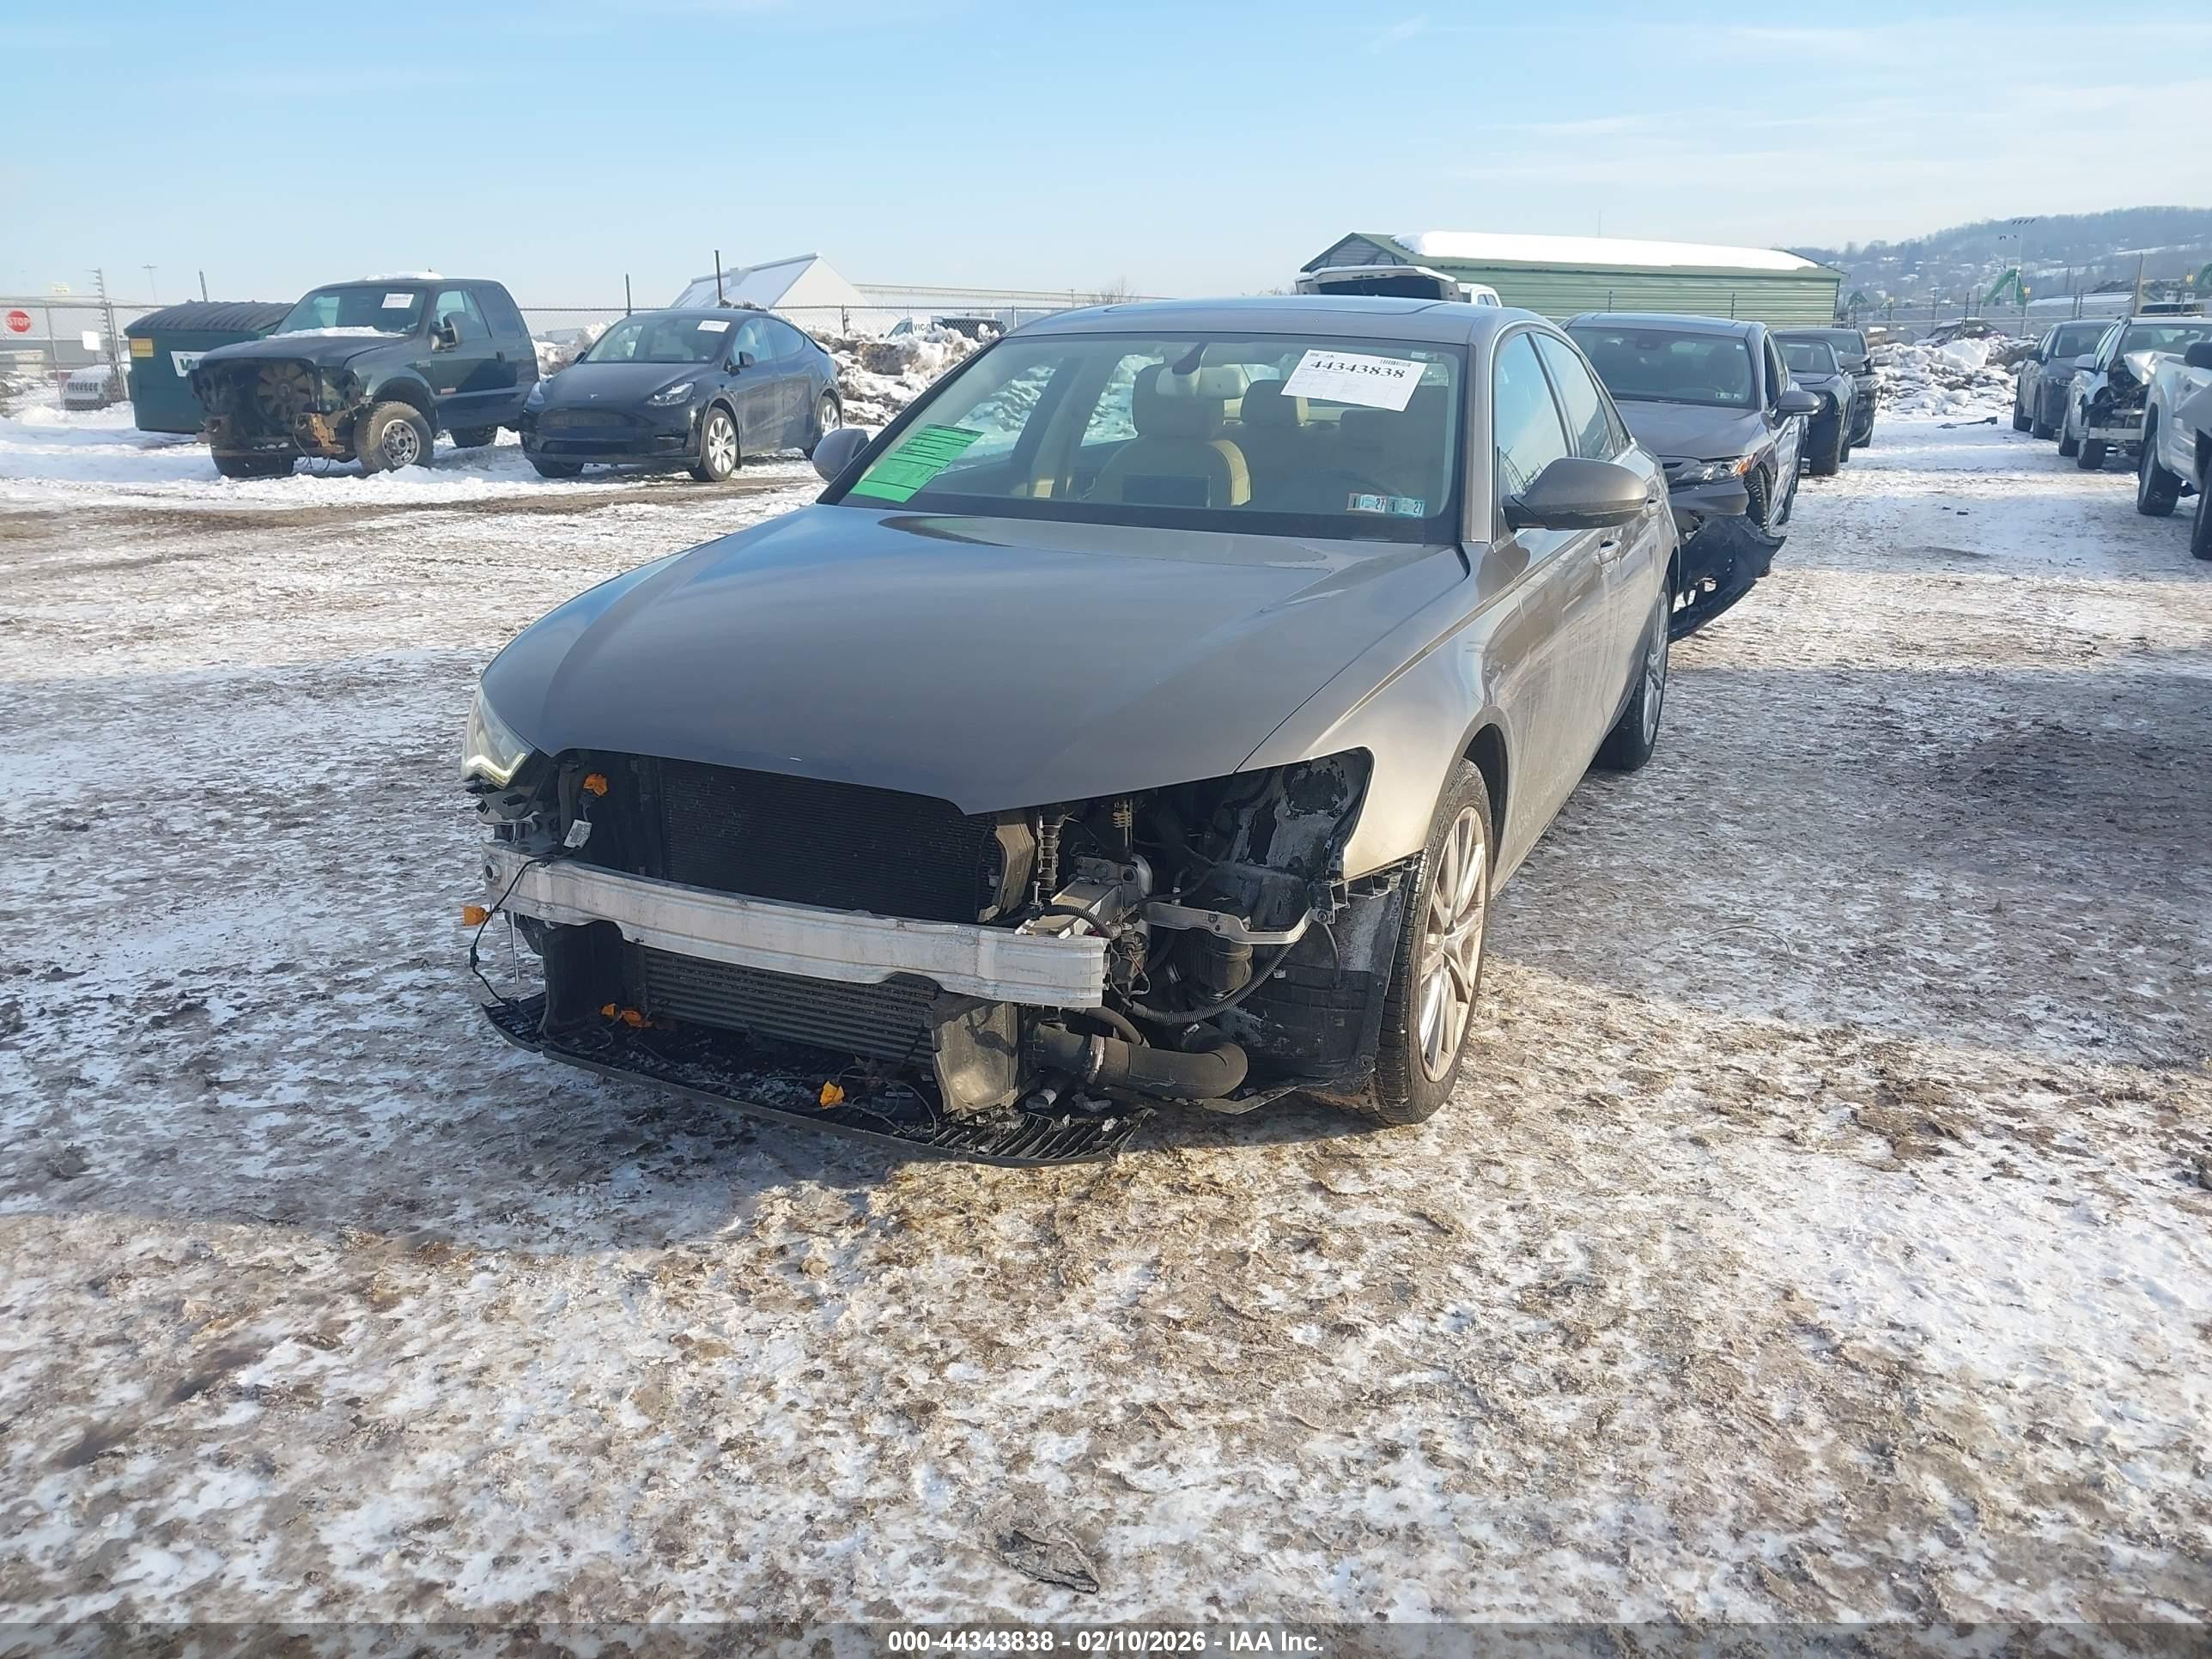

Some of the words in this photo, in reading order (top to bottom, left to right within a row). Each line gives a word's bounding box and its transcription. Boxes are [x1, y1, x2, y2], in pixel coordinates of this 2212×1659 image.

[7, 317, 29, 326] STOP
[1310, 361, 1406, 379] 44343838
[1376, 498, 1385, 511] 27
[1413, 501, 1423, 514] 27
